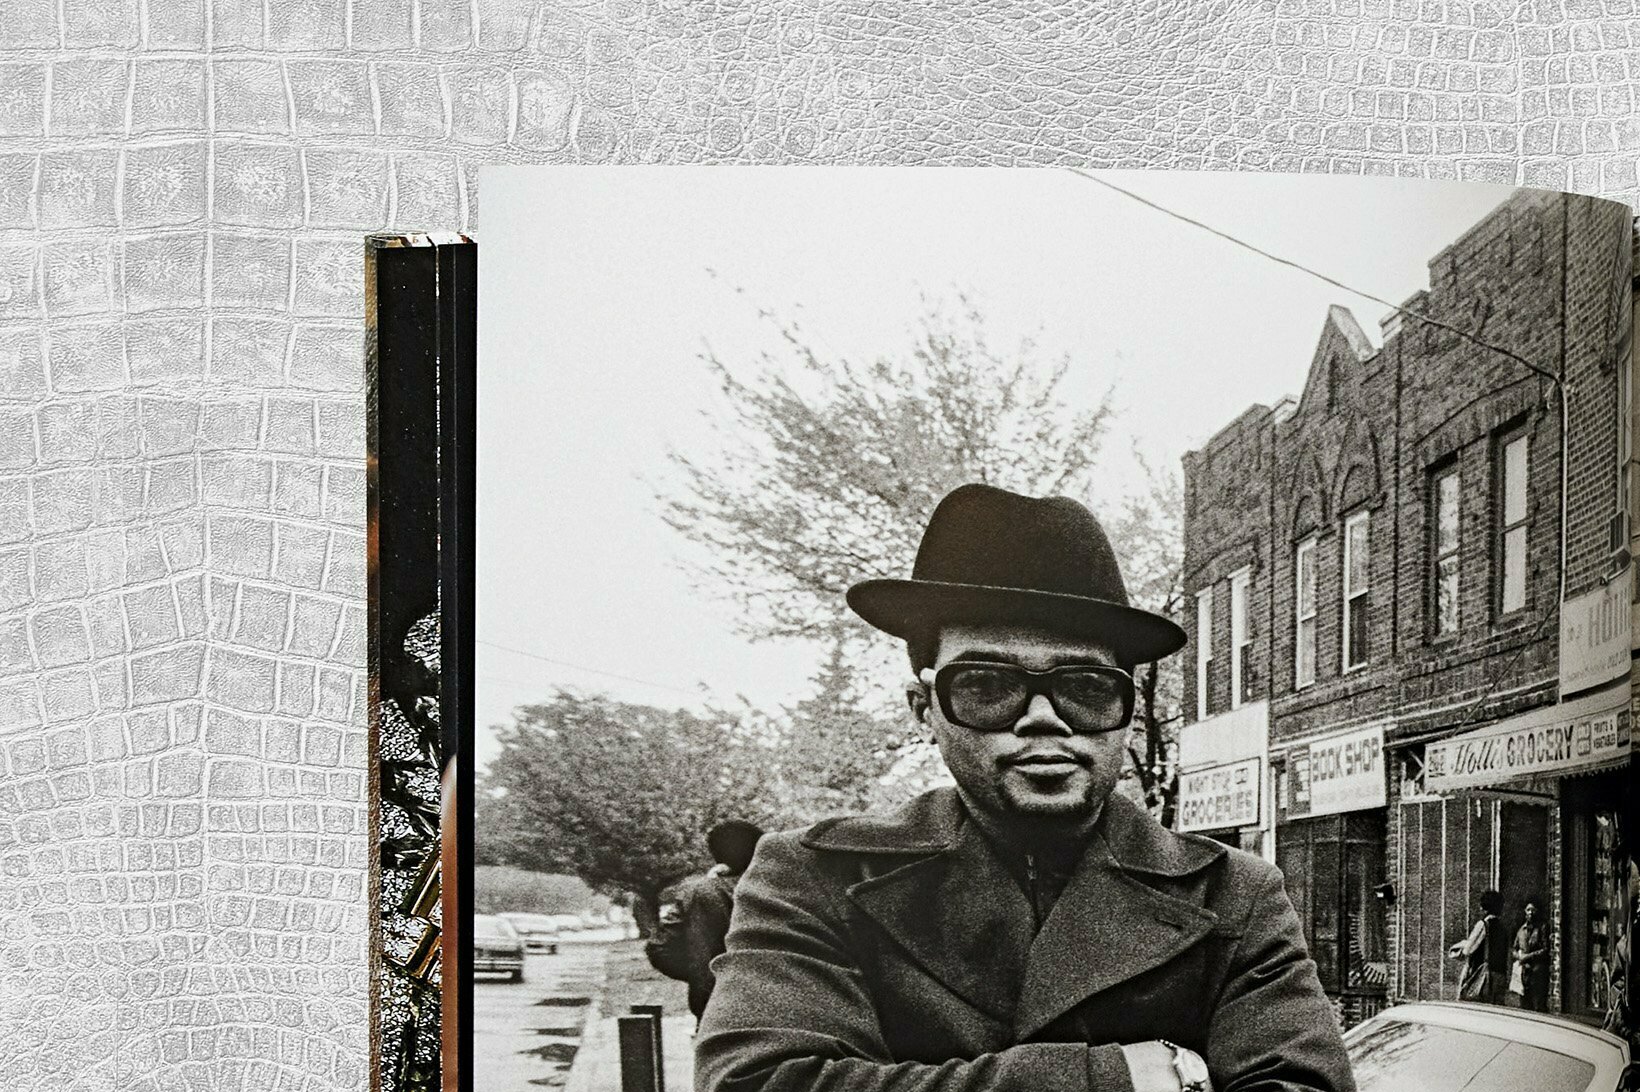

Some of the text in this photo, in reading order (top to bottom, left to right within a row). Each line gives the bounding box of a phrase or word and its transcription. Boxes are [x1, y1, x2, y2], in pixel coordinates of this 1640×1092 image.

[1312, 736, 1380, 783] BOOK SHOP
[1507, 724, 1575, 767] GROCERY
